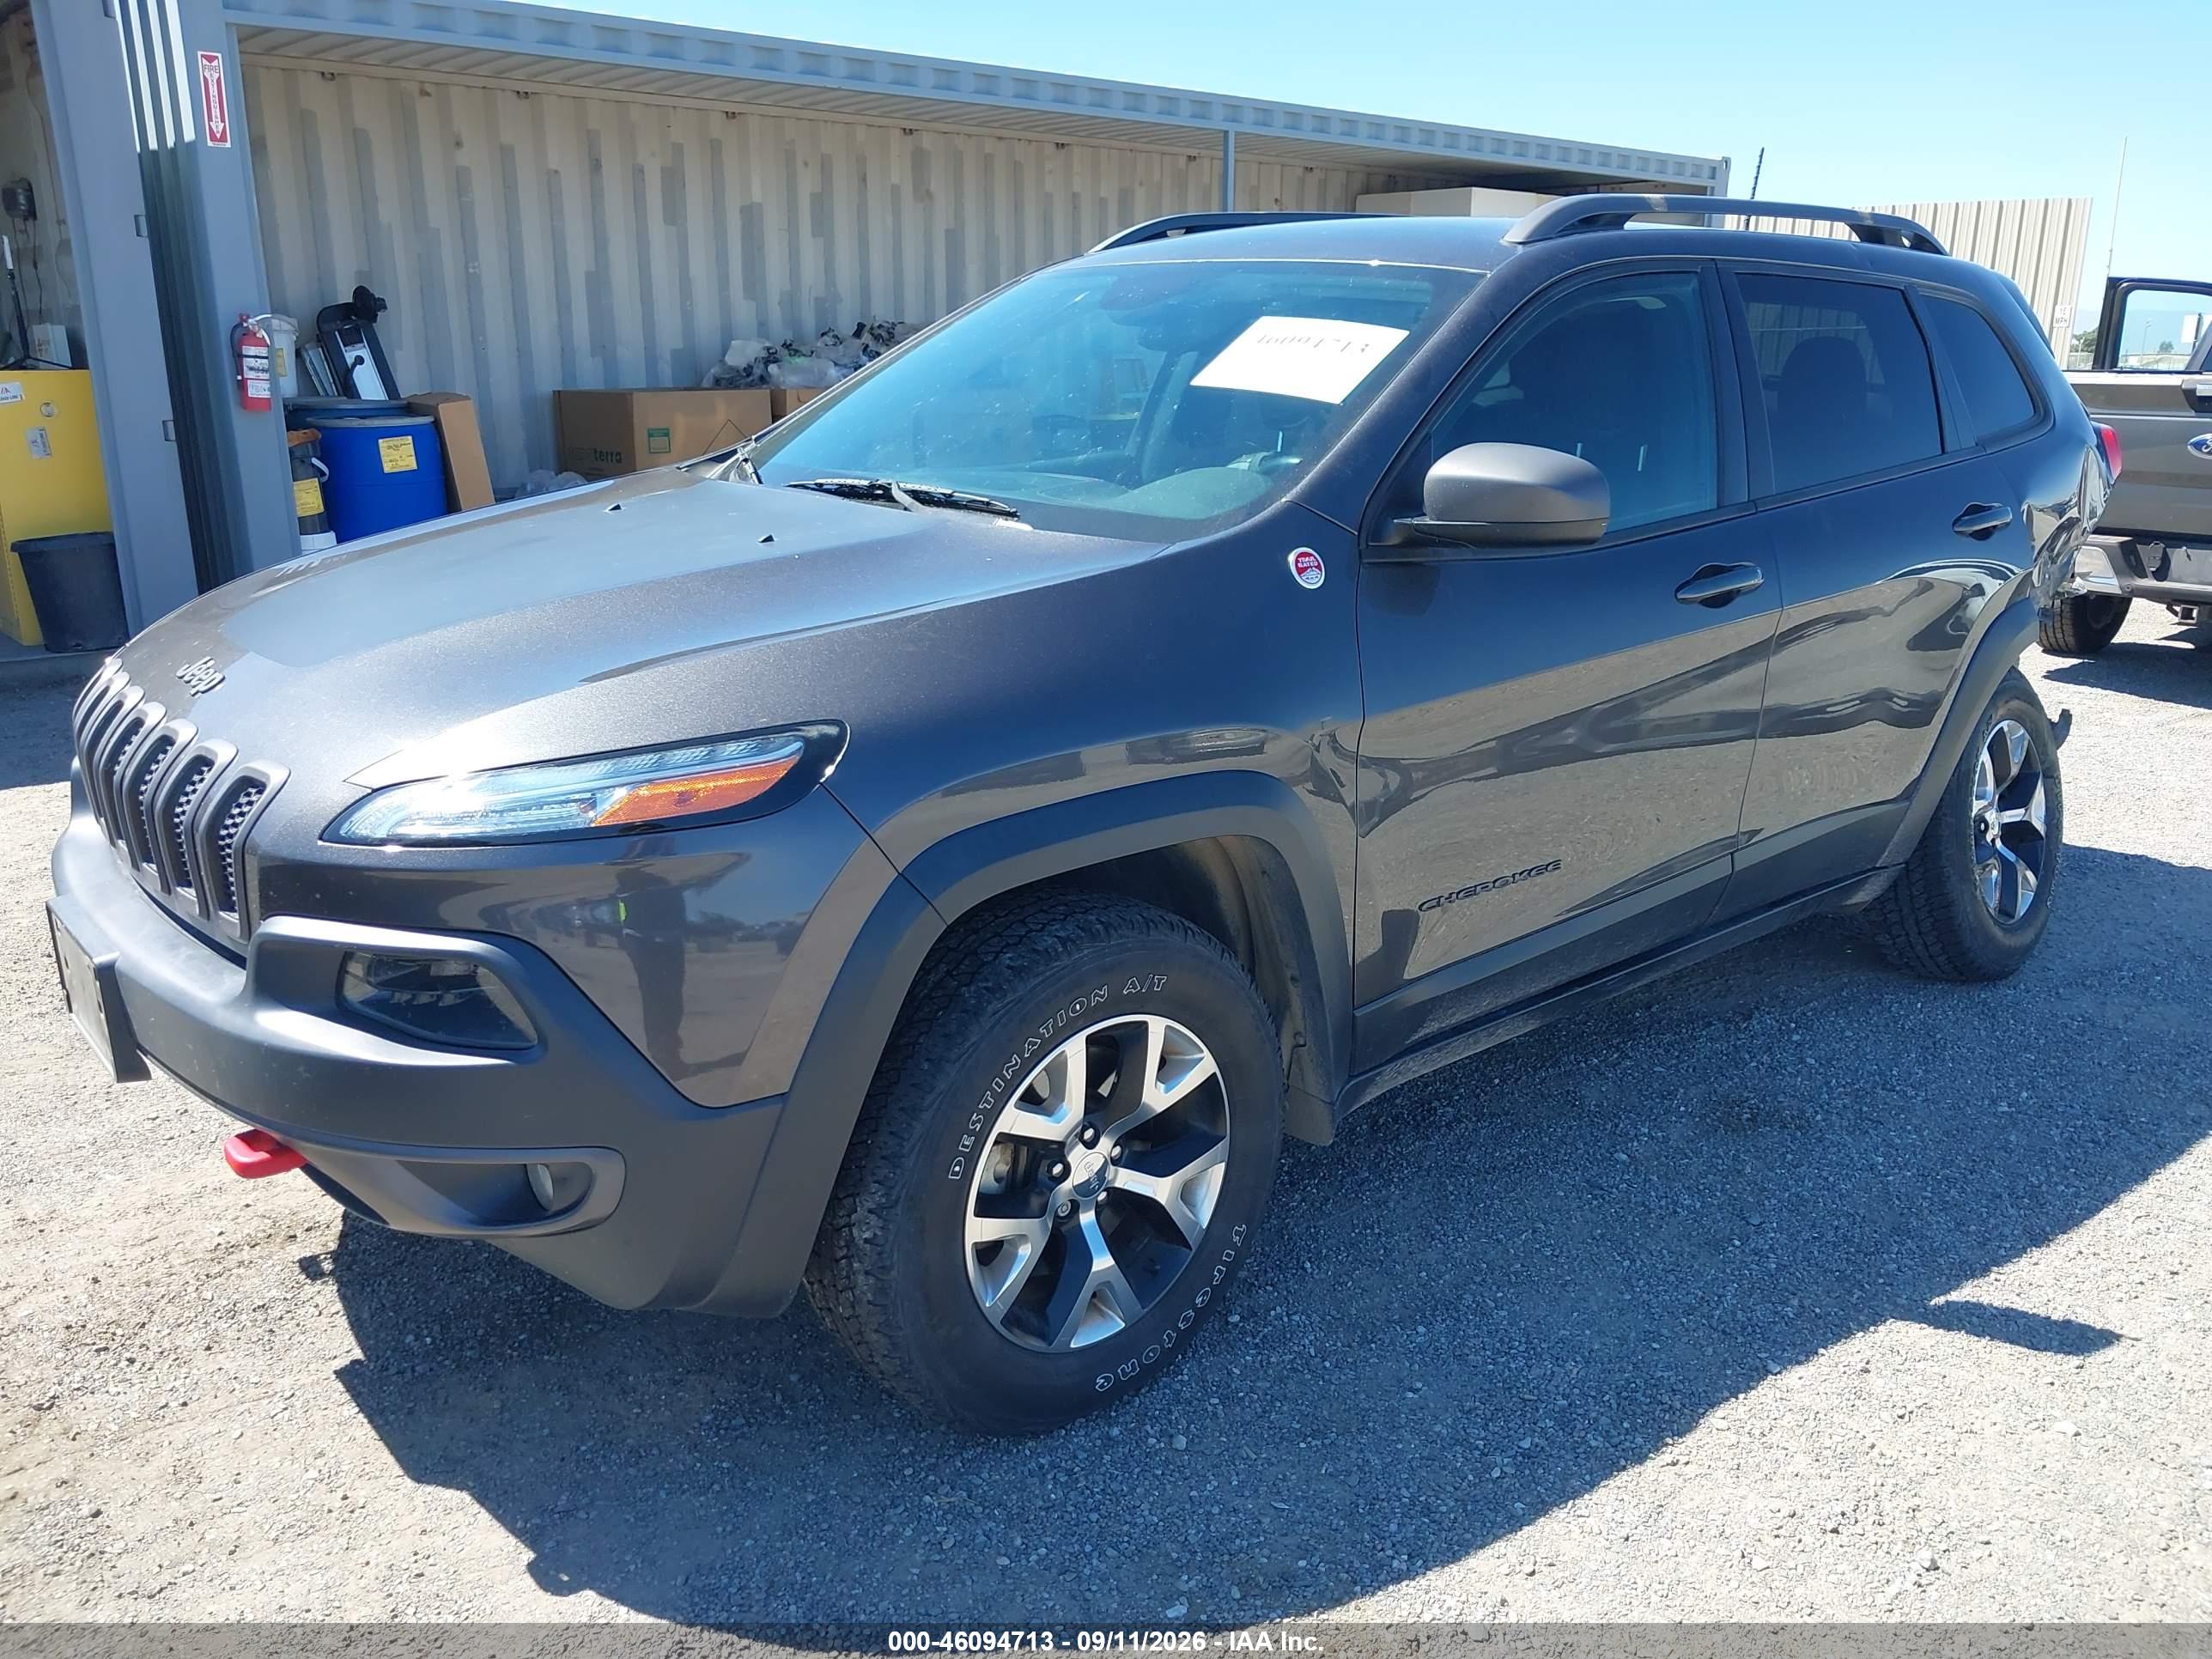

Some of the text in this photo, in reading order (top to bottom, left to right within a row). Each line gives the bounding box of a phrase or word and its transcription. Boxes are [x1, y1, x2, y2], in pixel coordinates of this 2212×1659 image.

[204, 64, 219, 74] FIRE
[210, 71, 220, 134] EXTINGUISHER
[176, 656, 225, 697] Jeep
[1418, 859, 1562, 912] CHEROKEE
[948, 974, 1168, 1180] DESTINATION A/T
